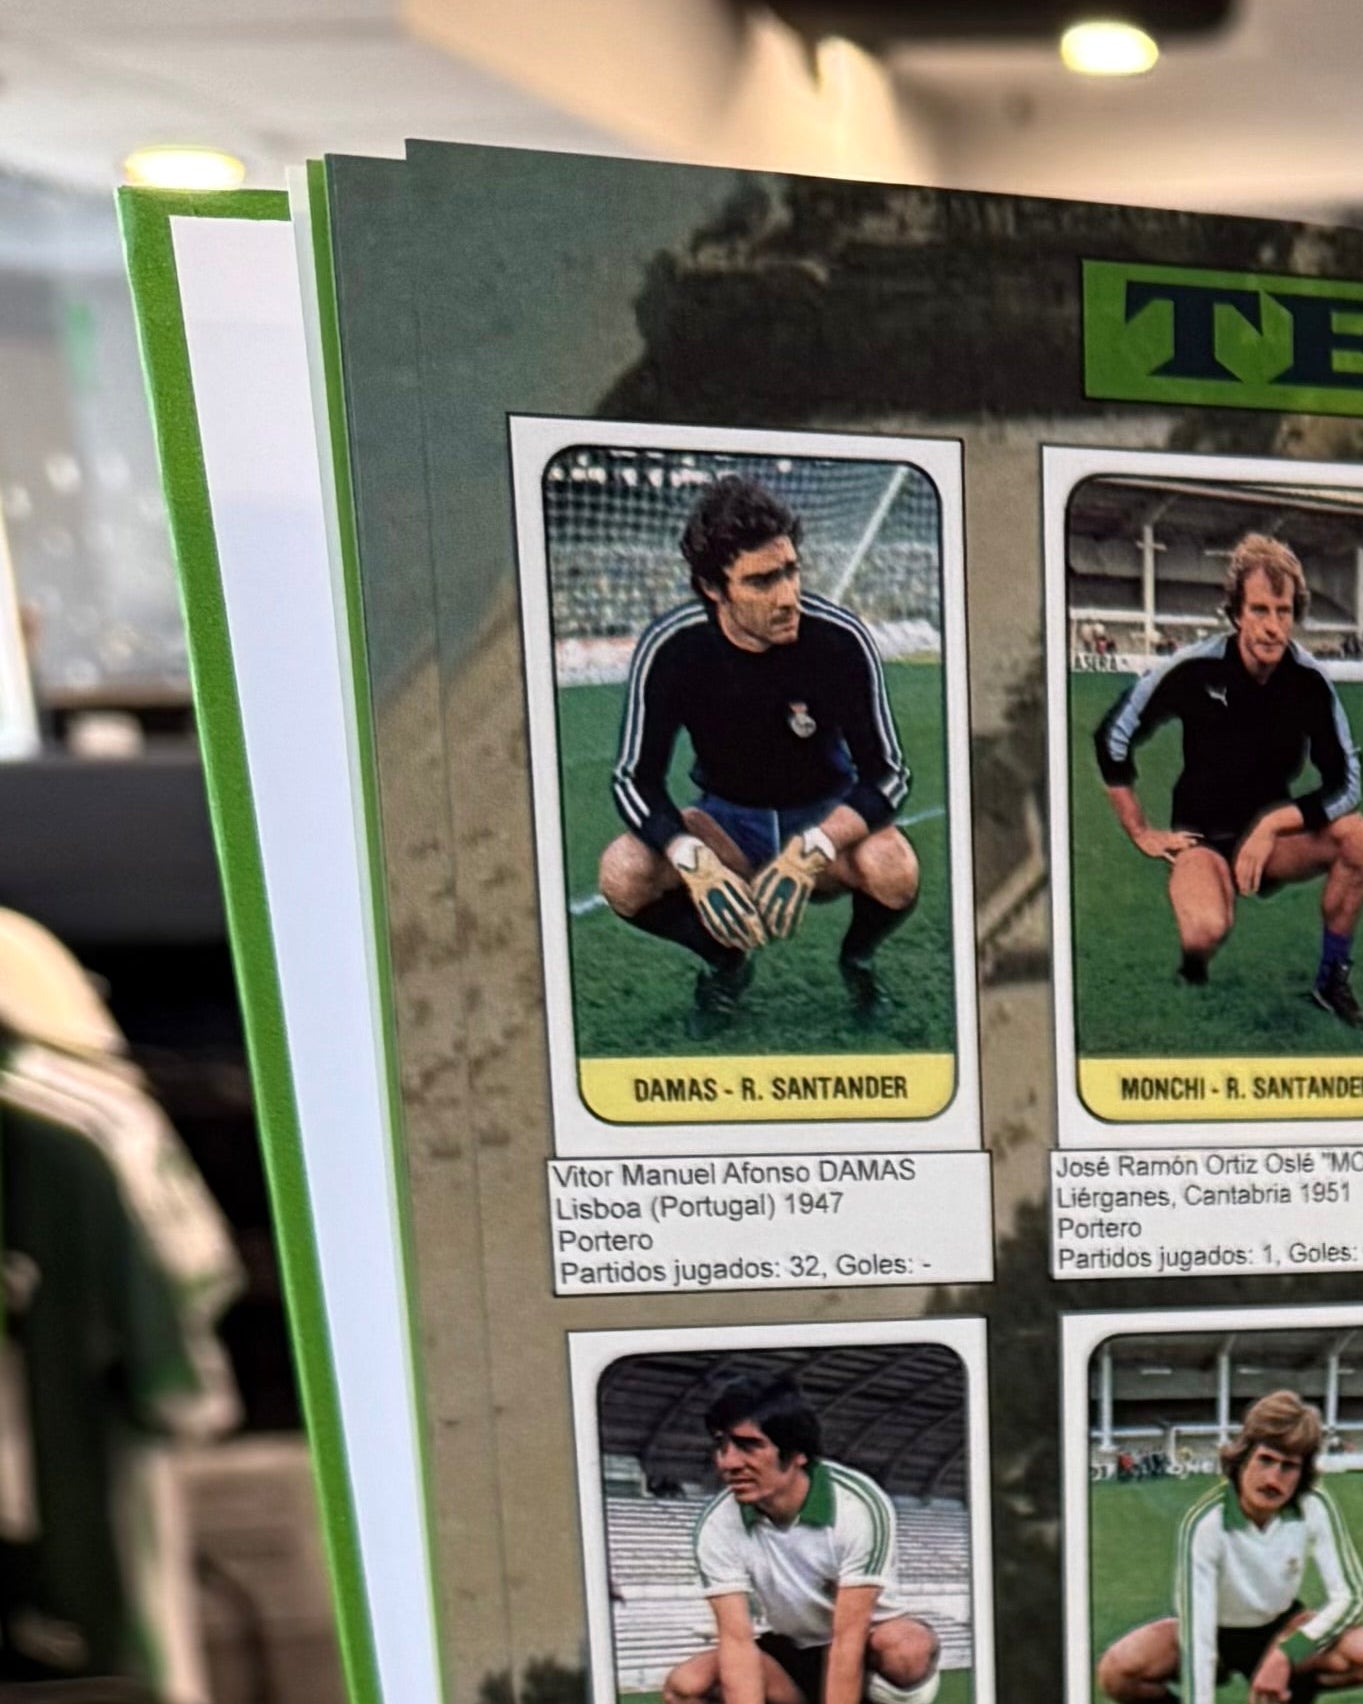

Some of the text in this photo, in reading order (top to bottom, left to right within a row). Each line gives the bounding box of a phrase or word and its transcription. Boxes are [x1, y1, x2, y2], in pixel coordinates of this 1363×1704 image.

[634, 1076, 908, 1102] DAMAS R. SANTANDER
[1121, 1077, 1205, 1100] MONCHI
[1227, 1076, 1245, 1099] R.
[552, 1158, 916, 1187] Vitor Manuel Afonso DAMAS
[556, 1193, 843, 1222] Lisboa (Portugal) 1947
[559, 1230, 653, 1251] Portero
[561, 1254, 913, 1286] Partidos jugados: 32, Goles:
